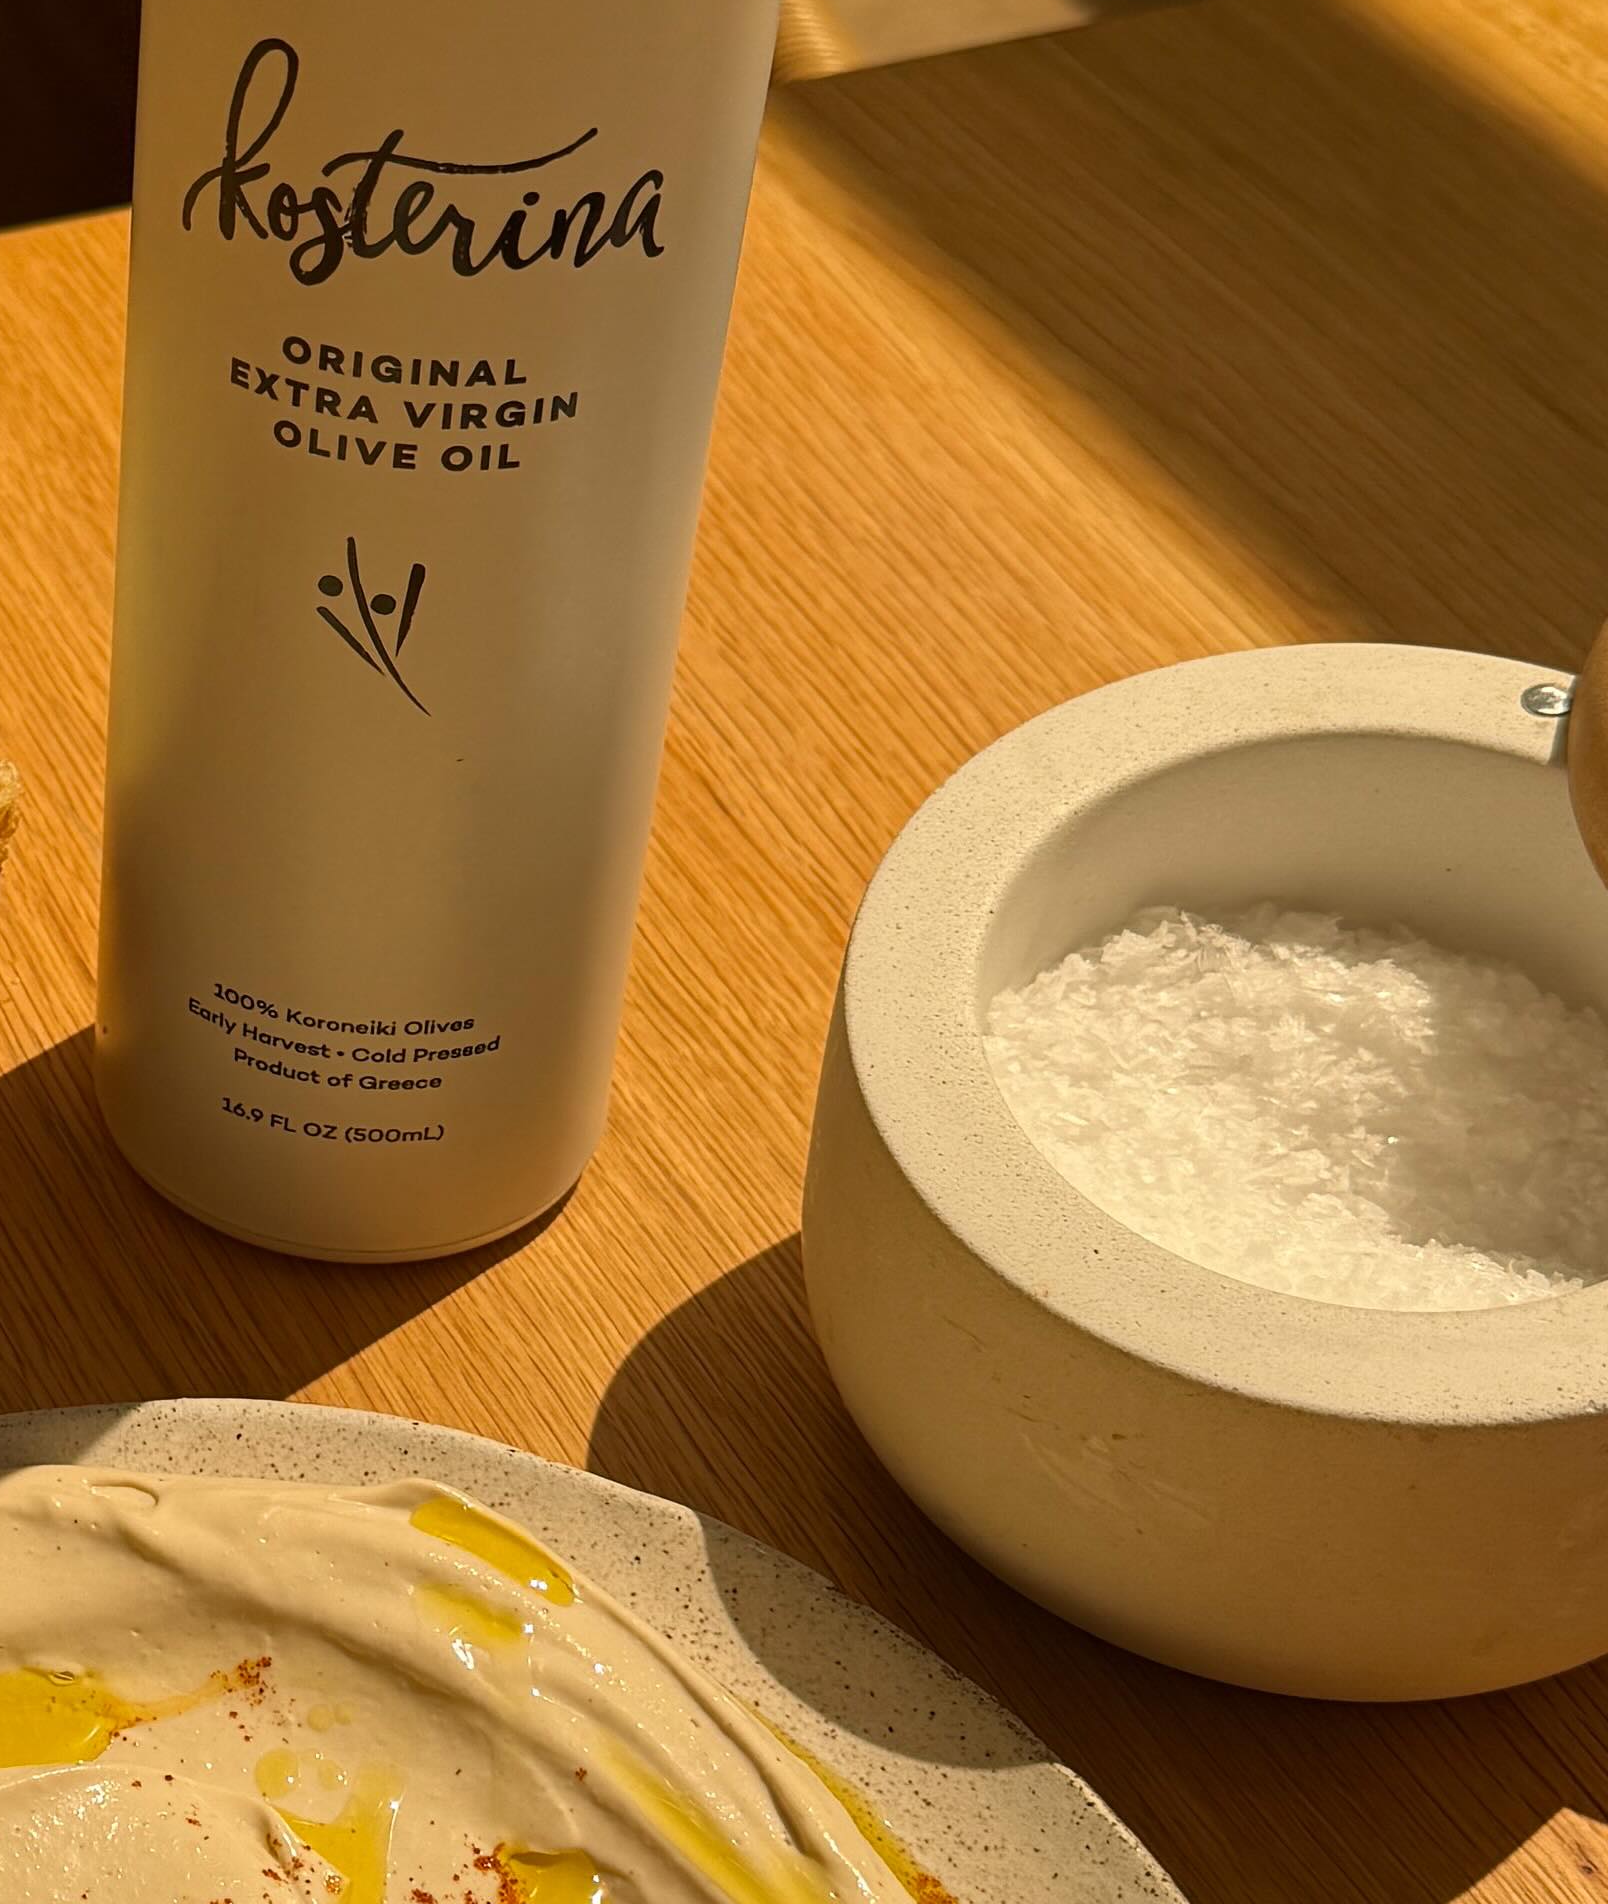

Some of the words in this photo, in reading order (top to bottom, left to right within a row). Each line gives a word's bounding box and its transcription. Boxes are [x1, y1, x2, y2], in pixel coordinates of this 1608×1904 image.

[183, 38, 664, 285] kosterina
[282, 336, 527, 386] ORIGINAL
[230, 357, 378, 423] EXTRA
[403, 392, 578, 429] VIRGIN
[273, 420, 418, 469] OLIVE
[441, 443, 520, 472] OIL
[188, 997, 236, 1034] Early
[242, 1023, 331, 1059] Harvest
[351, 1047, 406, 1063] Cold
[412, 1035, 501, 1063] Pressed
[214, 983, 279, 1019] 100%
[286, 1008, 396, 1036] Koroneiki
[404, 1017, 474, 1036] Olives
[233, 1048, 321, 1084] Product
[327, 1074, 353, 1088] of
[358, 1075, 442, 1090] Greece
[222, 1097, 264, 1122] 16.9
[270, 1113, 297, 1133] FL
[303, 1122, 337, 1140] OZ
[345, 1125, 445, 1143] (500mL)
